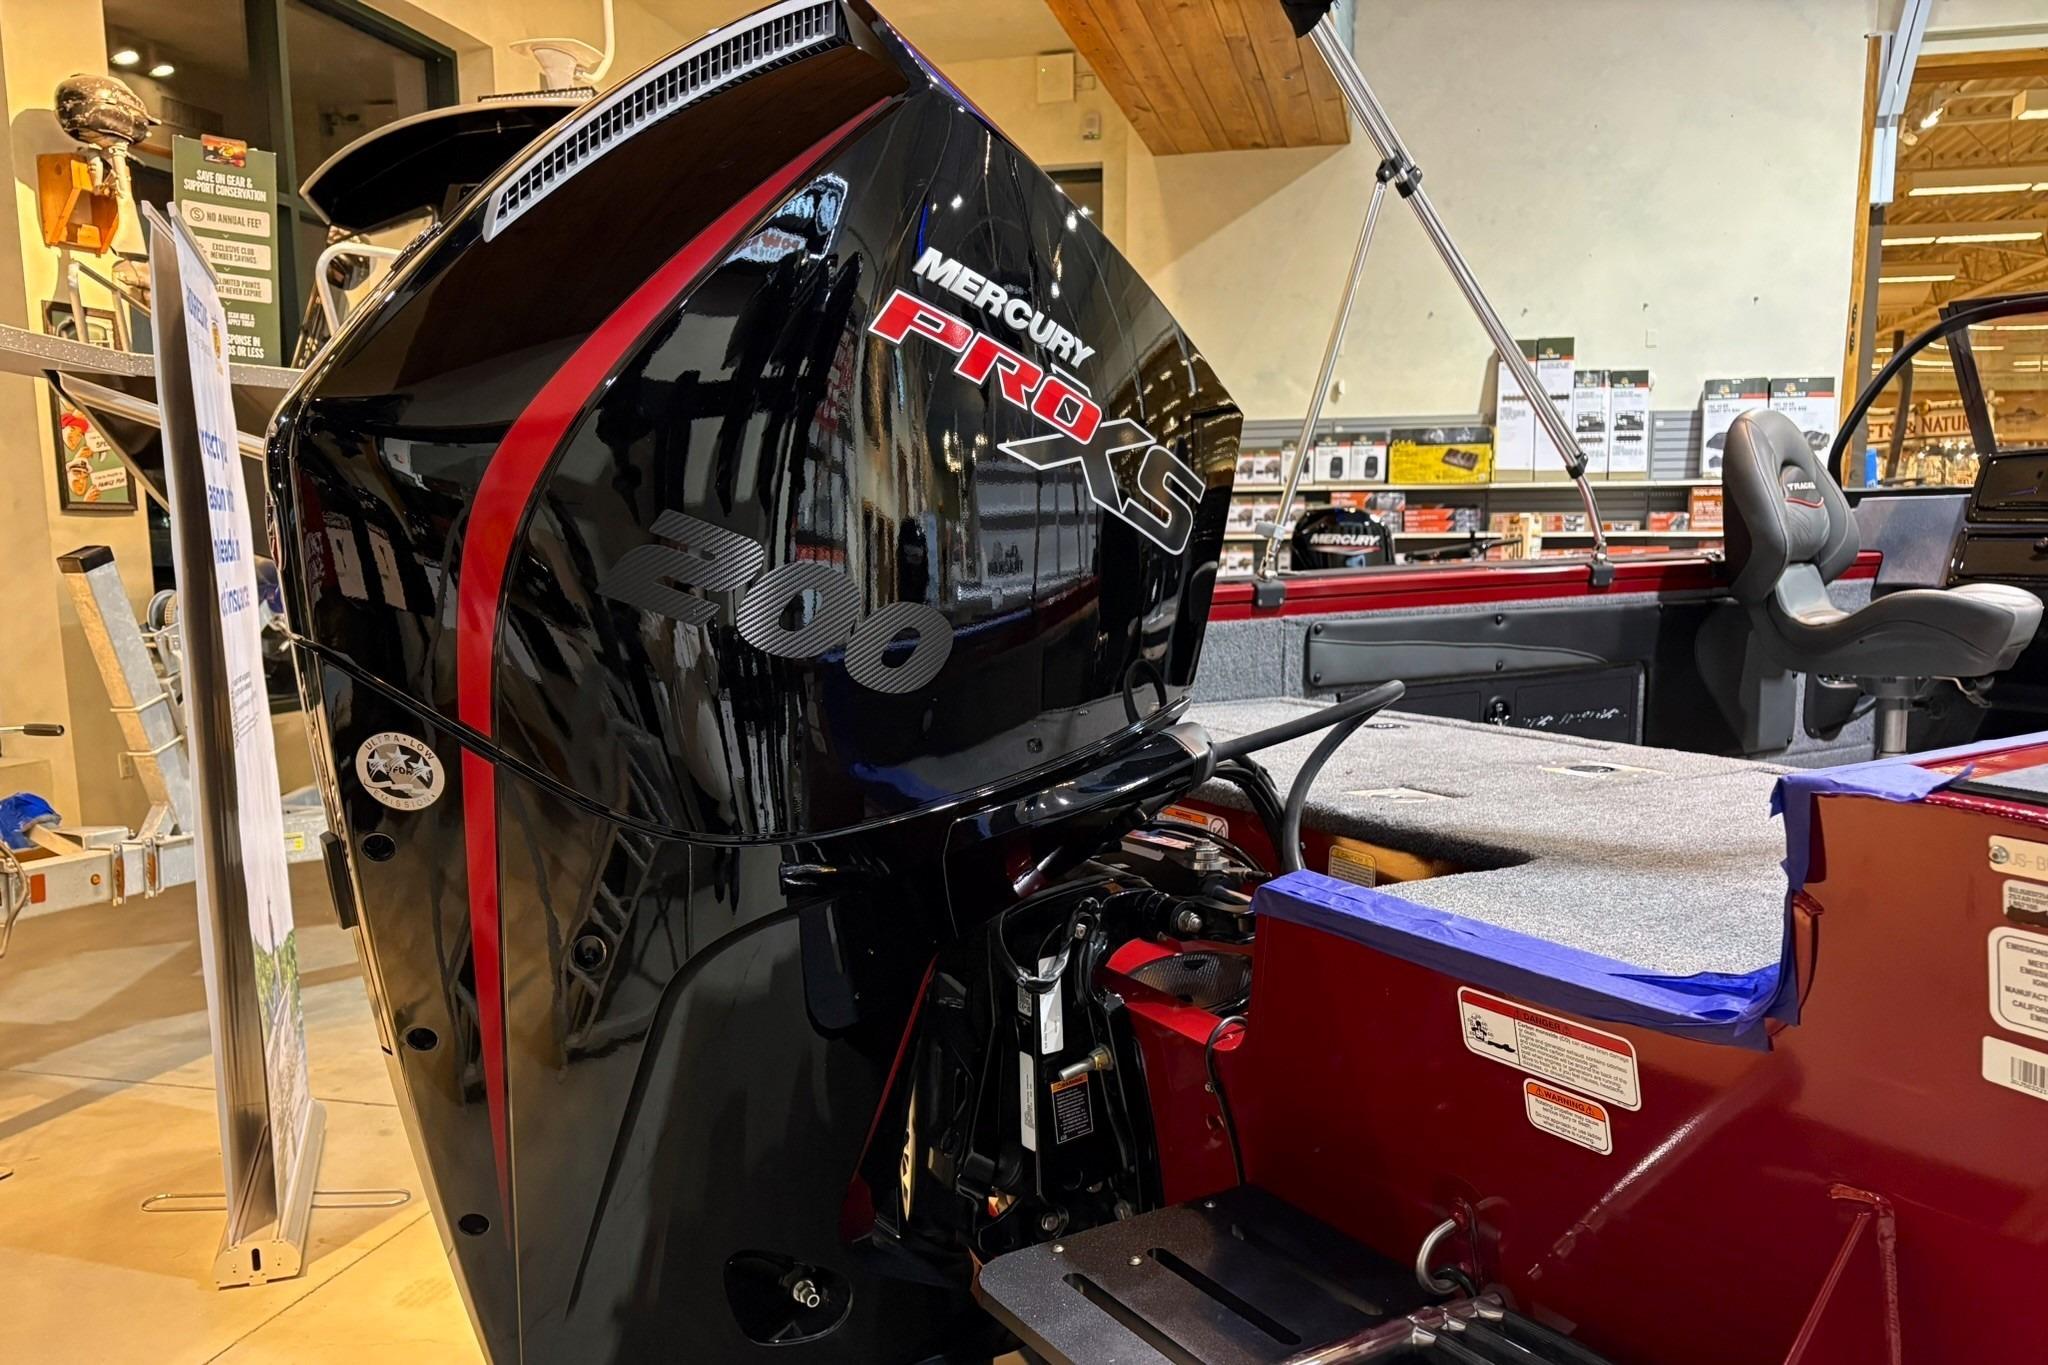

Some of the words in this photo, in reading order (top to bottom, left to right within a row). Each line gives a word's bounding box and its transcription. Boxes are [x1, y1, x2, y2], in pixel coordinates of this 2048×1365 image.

[196, 170, 214, 183] SAVE
[215, 173, 225, 184] ON
[227, 175, 245, 188] GEAR
[246, 178, 253, 188] &
[184, 178, 214, 194] SUPPORT
[216, 185, 266, 202] CONSERVATION
[207, 212, 216, 222] NO
[218, 214, 245, 226] ANNUAL
[210, 251, 232, 261] MEMBER
[234, 255, 256, 264] SAVINGS
[212, 243, 239, 254] EXCLUSIVE
[241, 247, 254, 256] CLUB
[226, 287, 242, 296] NEVER
[244, 289, 262, 298] EXPIRE
[242, 280, 260, 289] POINTS
[913, 246, 1095, 368] MERCURY
[237, 346, 246, 356] OR
[248, 347, 264, 358] LESS
[868, 288, 1102, 444] PRO
[998, 417, 1205, 555] XS
[1310, 533, 1381, 546] MERCURY
[596, 509, 954, 694] 200
[365, 734, 400, 751] ULTRA
[410, 740, 434, 760] LOW
[372, 789, 432, 808] EMISSION
[1523, 1012, 1562, 1032] DANGER
[1544, 1090, 1585, 1112] WARNING
